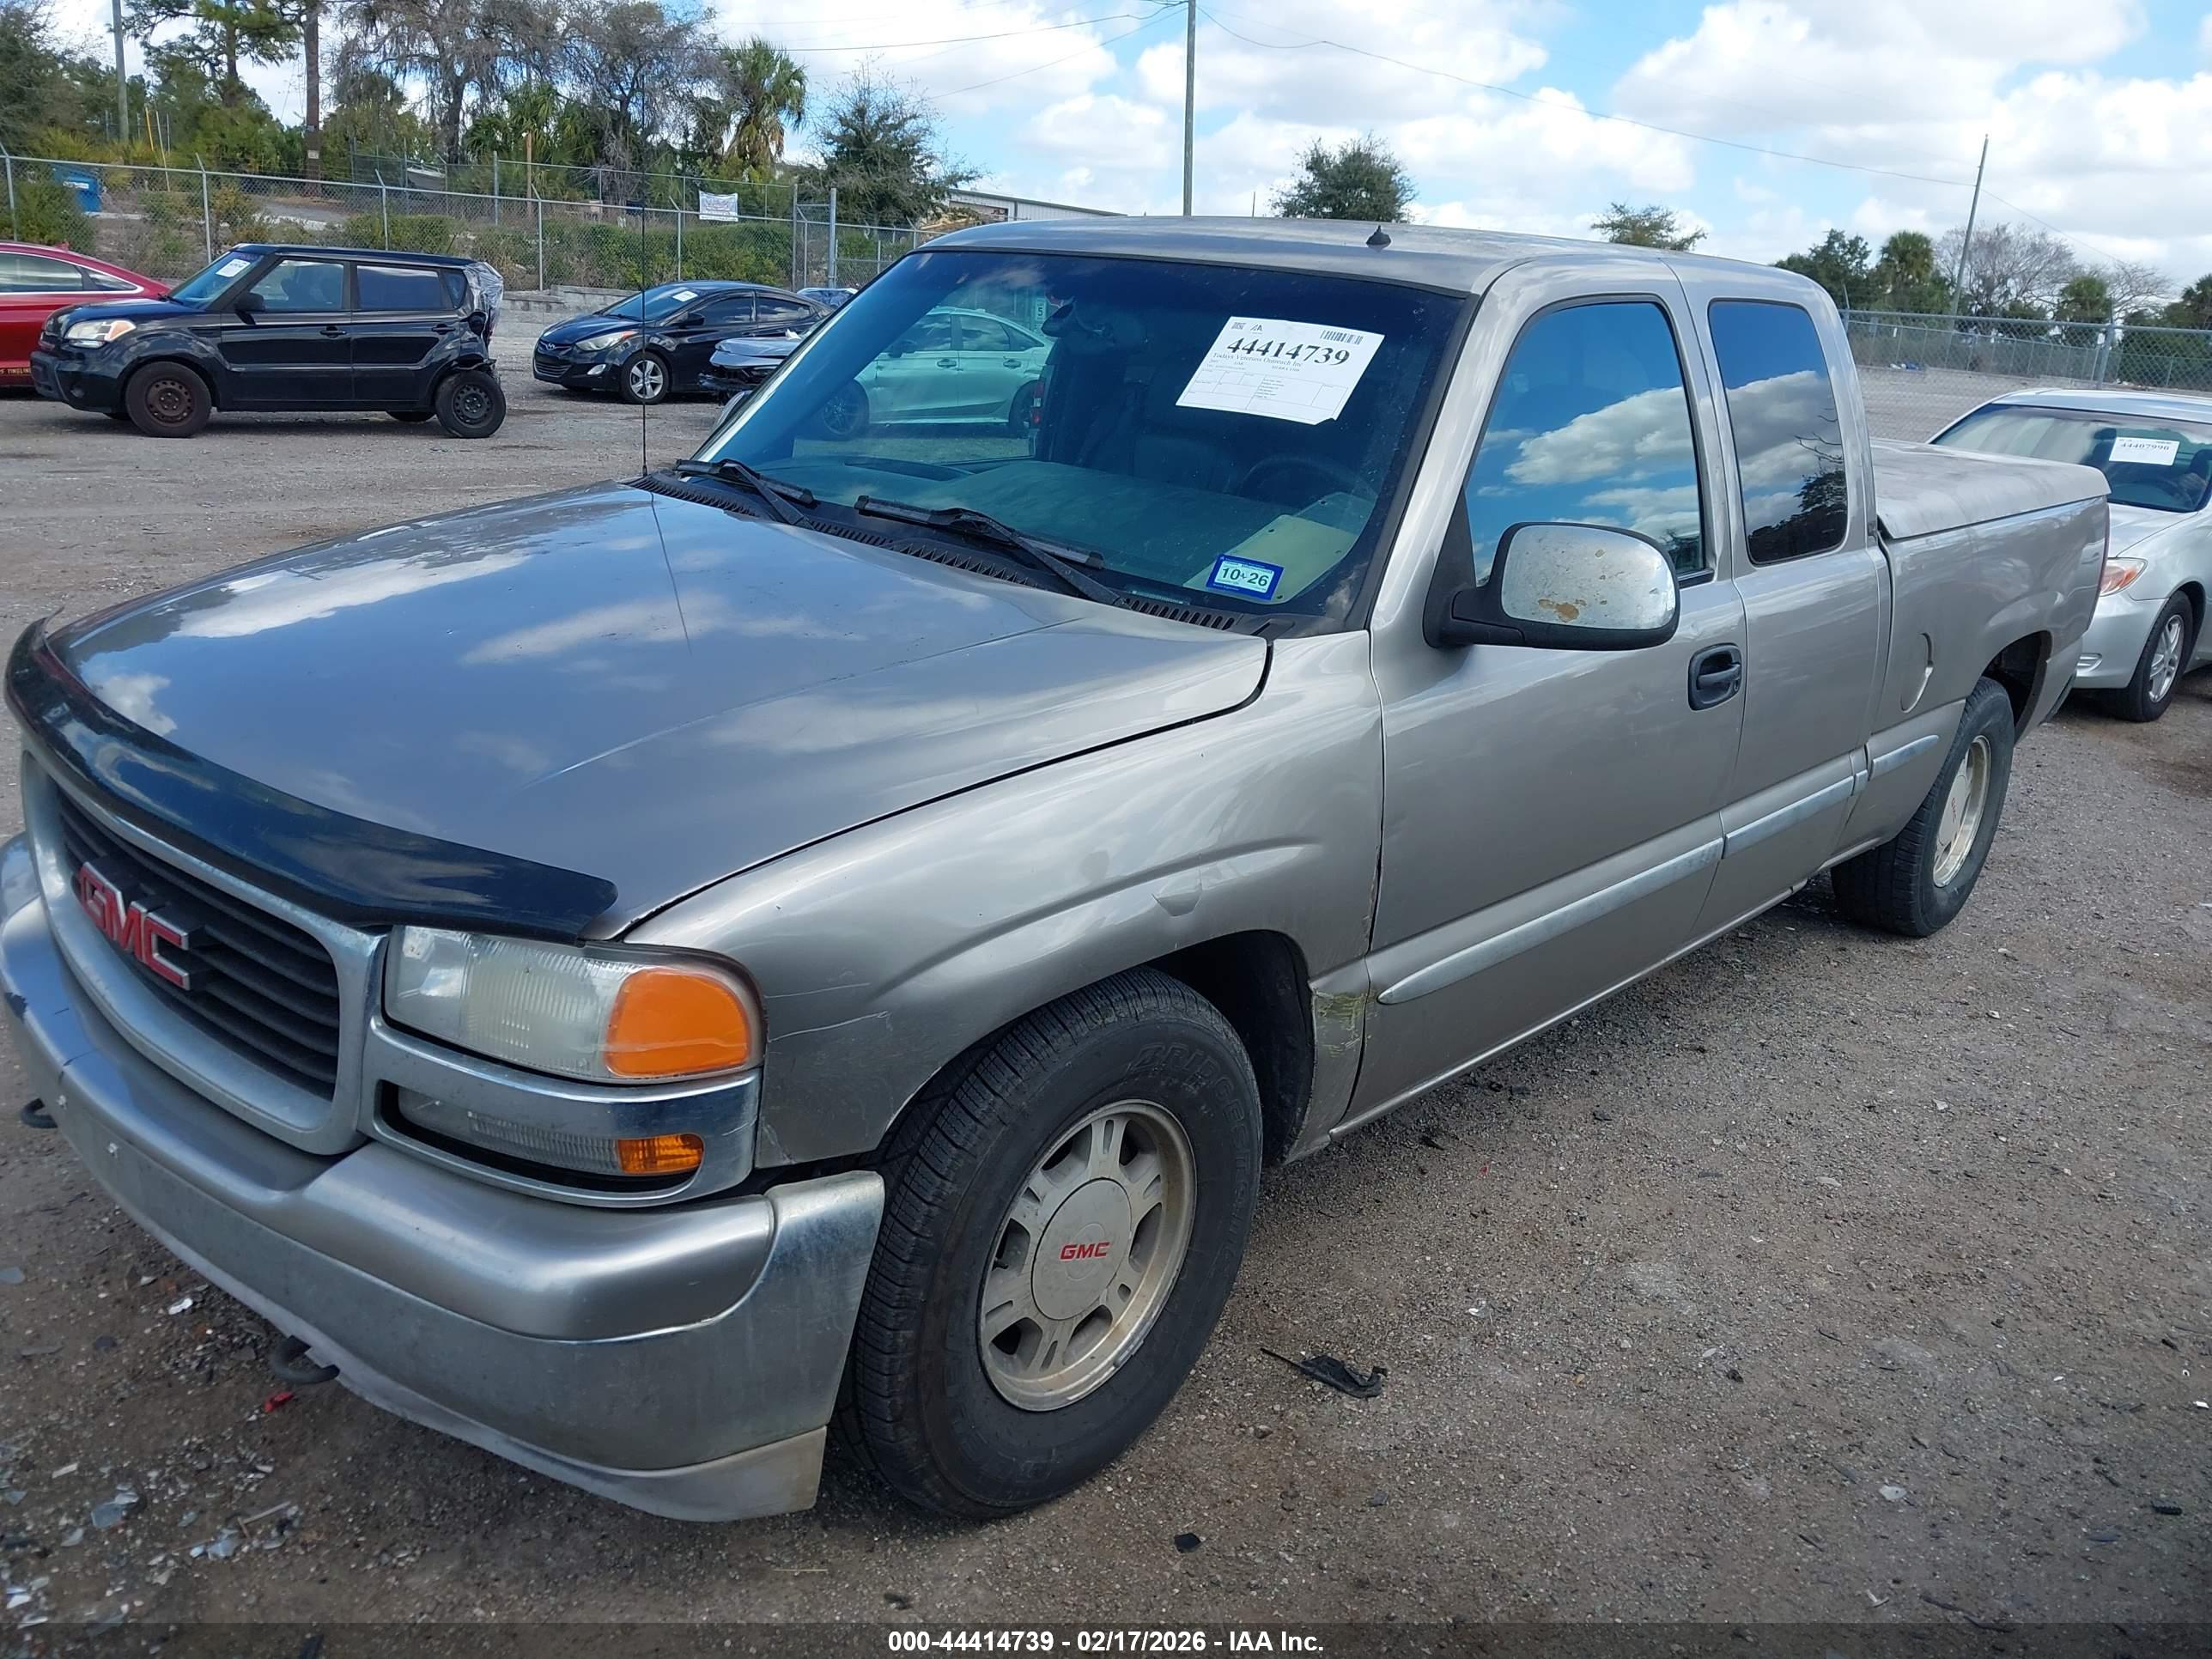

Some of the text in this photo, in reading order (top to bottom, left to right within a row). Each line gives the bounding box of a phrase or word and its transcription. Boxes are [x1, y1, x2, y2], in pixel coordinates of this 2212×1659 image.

[1037, 307, 1043, 317] 5
[1227, 337, 1351, 366] 44414739
[1263, 356, 1291, 366] Outreach
[1222, 568, 1241, 580] 10
[1247, 572, 1269, 587] 26
[77, 861, 191, 991] GMC
[1060, 1242, 1111, 1261] GMC
